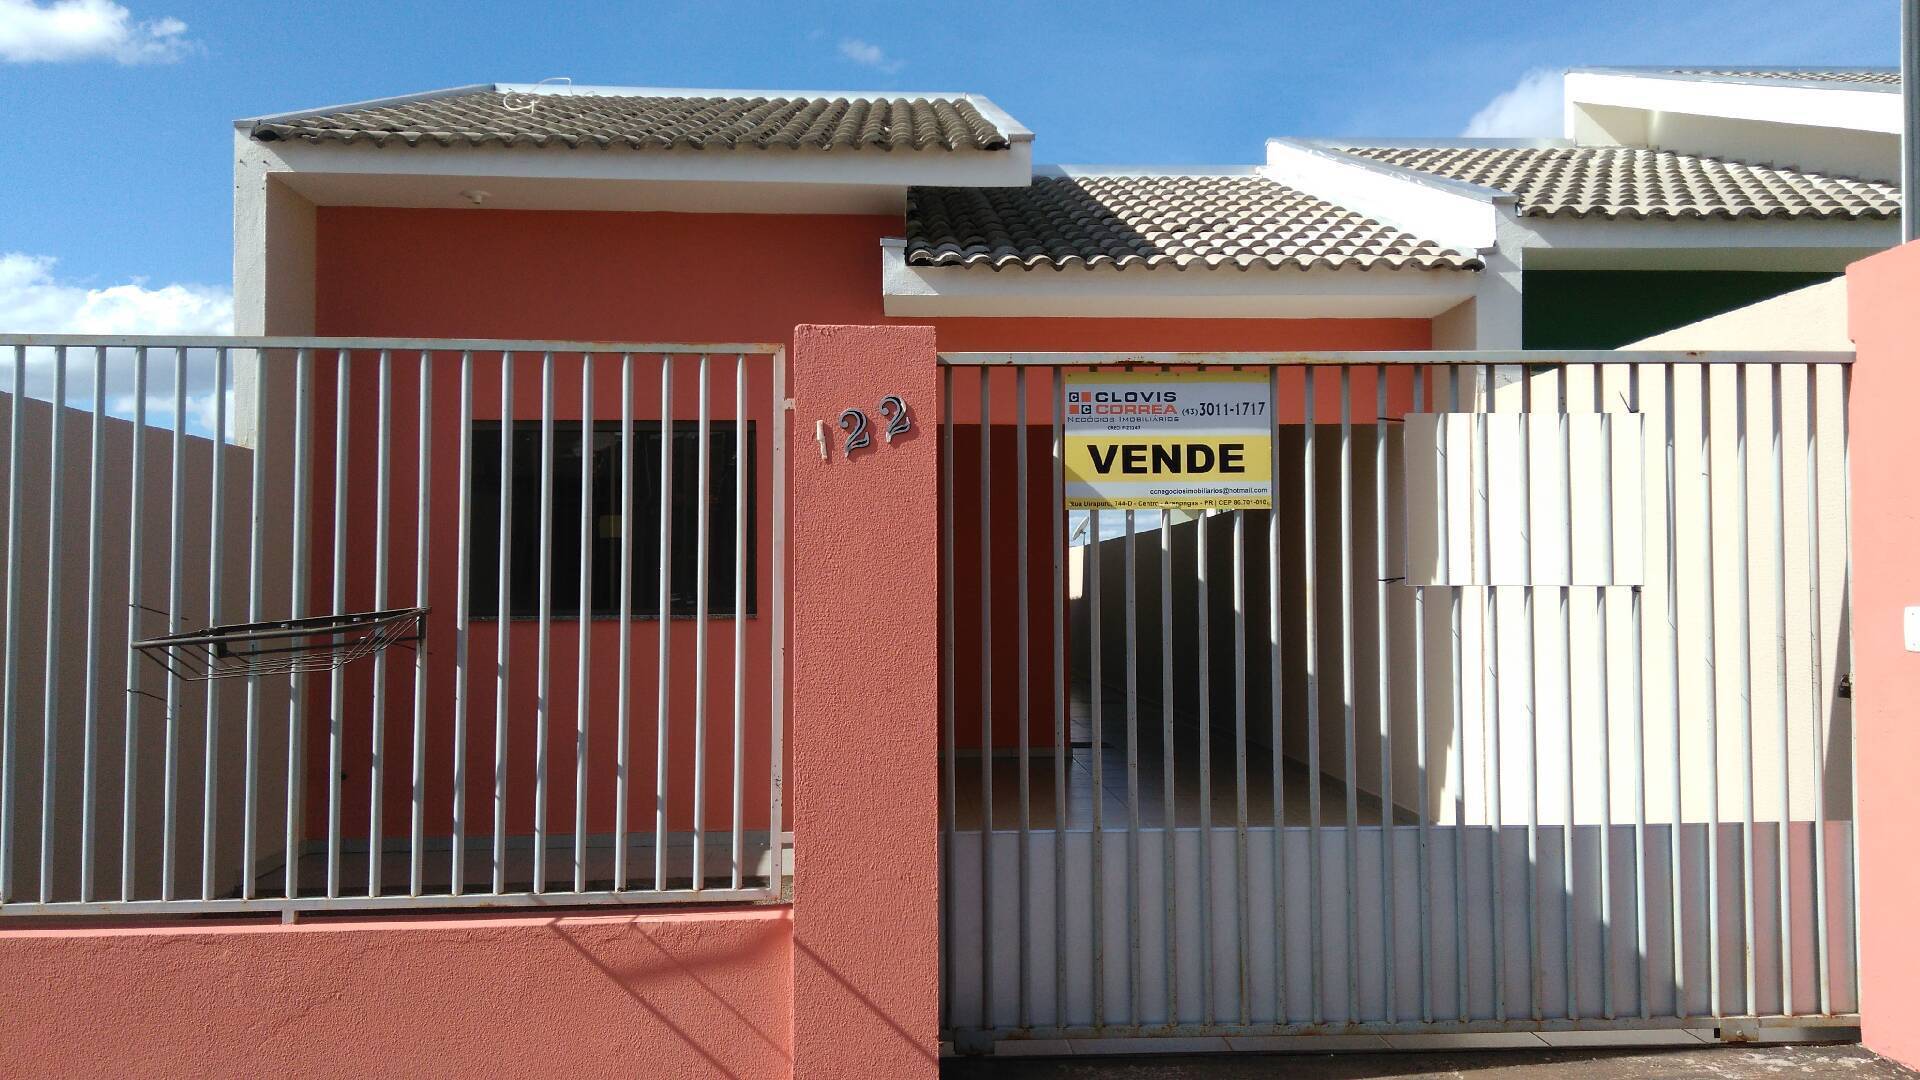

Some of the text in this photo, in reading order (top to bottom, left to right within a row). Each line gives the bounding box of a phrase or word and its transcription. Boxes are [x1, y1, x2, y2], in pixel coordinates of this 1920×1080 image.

[1095, 391, 1177, 403] CLOVIS
[1095, 404, 1178, 415] CORREA
[1087, 443, 1245, 474] VENDE
